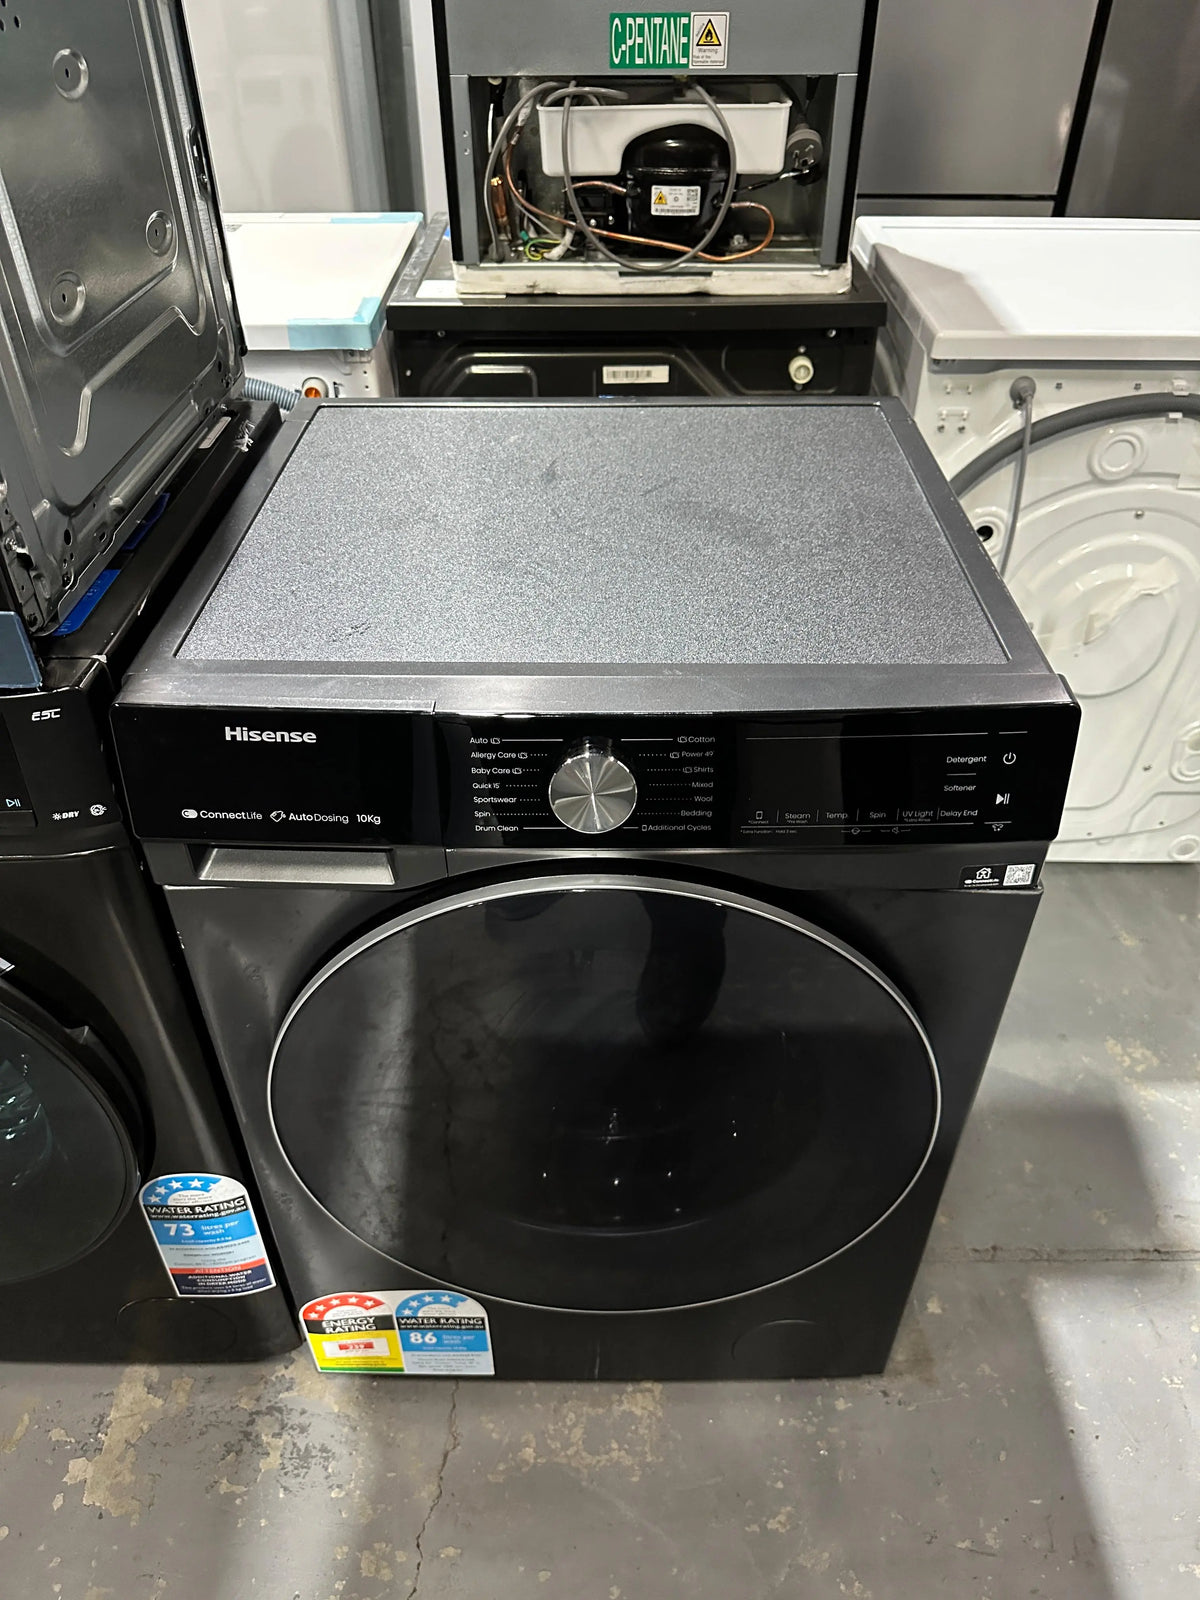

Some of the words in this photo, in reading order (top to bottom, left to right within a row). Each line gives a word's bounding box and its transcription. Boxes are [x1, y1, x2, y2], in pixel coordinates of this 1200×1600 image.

[612, 17, 689, 65] C-PENTANE
[224, 726, 317, 743] Hisense
[471, 752, 496, 760] Allergy
[946, 756, 987, 764] Detergent
[471, 767, 491, 775] Baby
[473, 796, 517, 804] Sportswear
[62, 811, 79, 819] DRY
[680, 810, 713, 818] Bedding
[785, 812, 811, 820] Steam
[826, 811, 848, 820] Temp
[869, 811, 887, 819] Spin
[903, 810, 913, 818] UV
[914, 810, 934, 819] Light
[940, 810, 962, 818] Delay
[356, 814, 381, 825] 10Kg
[687, 824, 712, 832] Cycles
[147, 1206, 193, 1214] WATER
[194, 1197, 245, 1213] RATING
[163, 1223, 195, 1237] 73
[321, 1317, 375, 1328] ENERGY
[325, 1323, 377, 1334] RATING
[409, 1331, 438, 1344] 86
